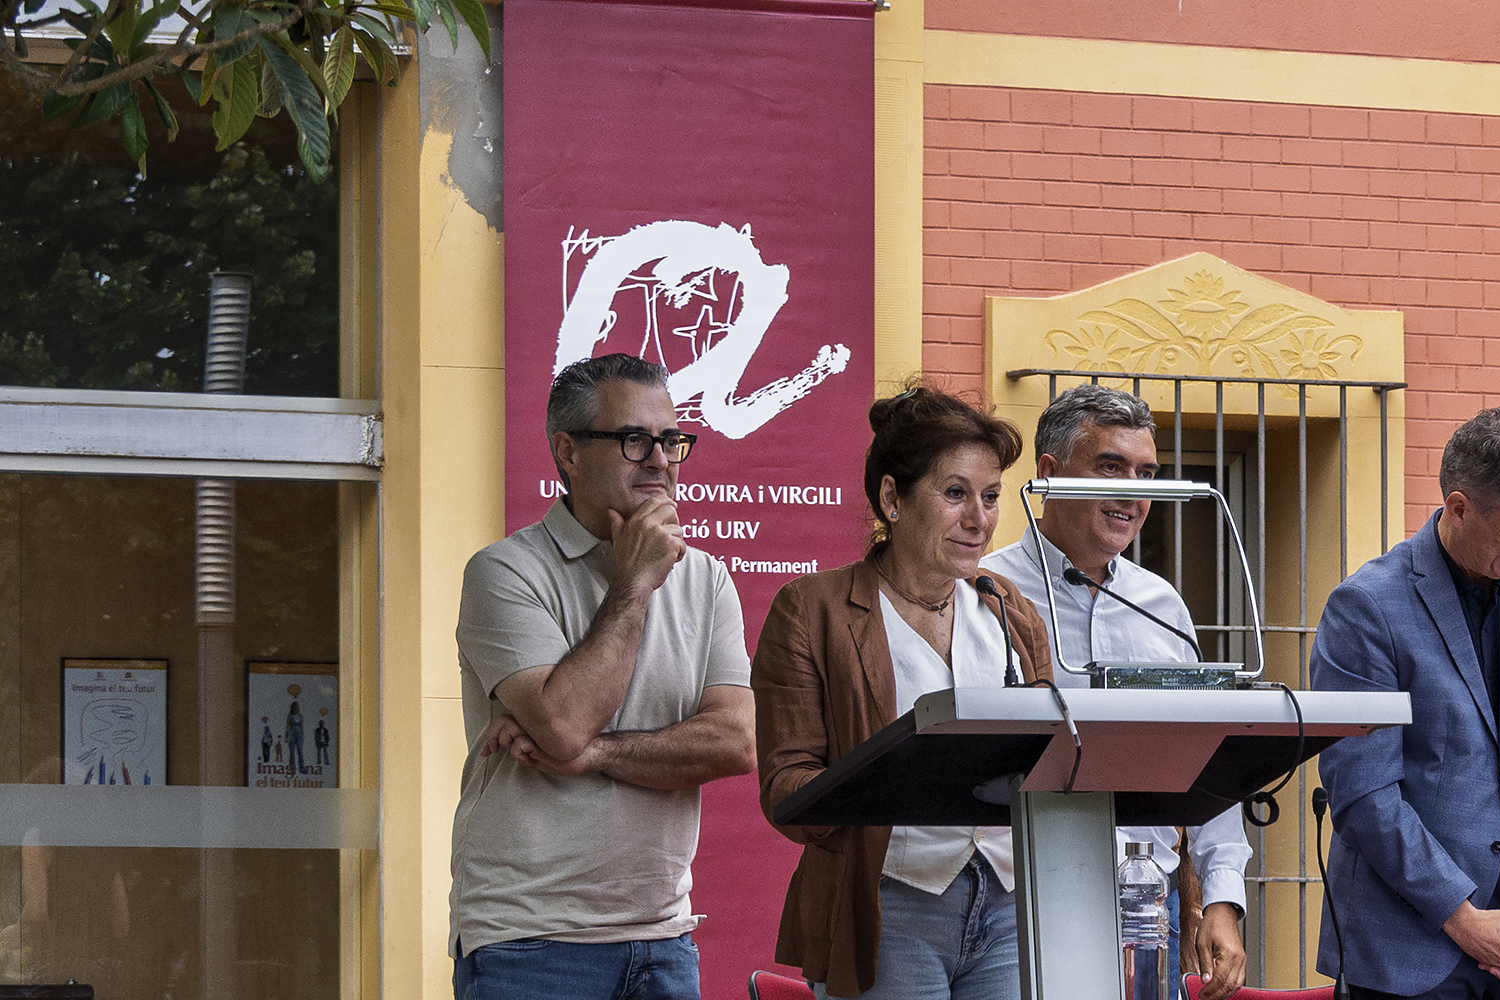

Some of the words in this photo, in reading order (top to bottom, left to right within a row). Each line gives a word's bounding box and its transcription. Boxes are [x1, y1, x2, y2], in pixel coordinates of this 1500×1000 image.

[540, 479, 569, 498] UN
[675, 483, 753, 503] ROVIRA
[758, 485, 764, 503] i
[768, 486, 842, 505] VIRGILI
[682, 519, 710, 538] ció
[716, 520, 760, 539] URV
[731, 556, 818, 573] Permanent
